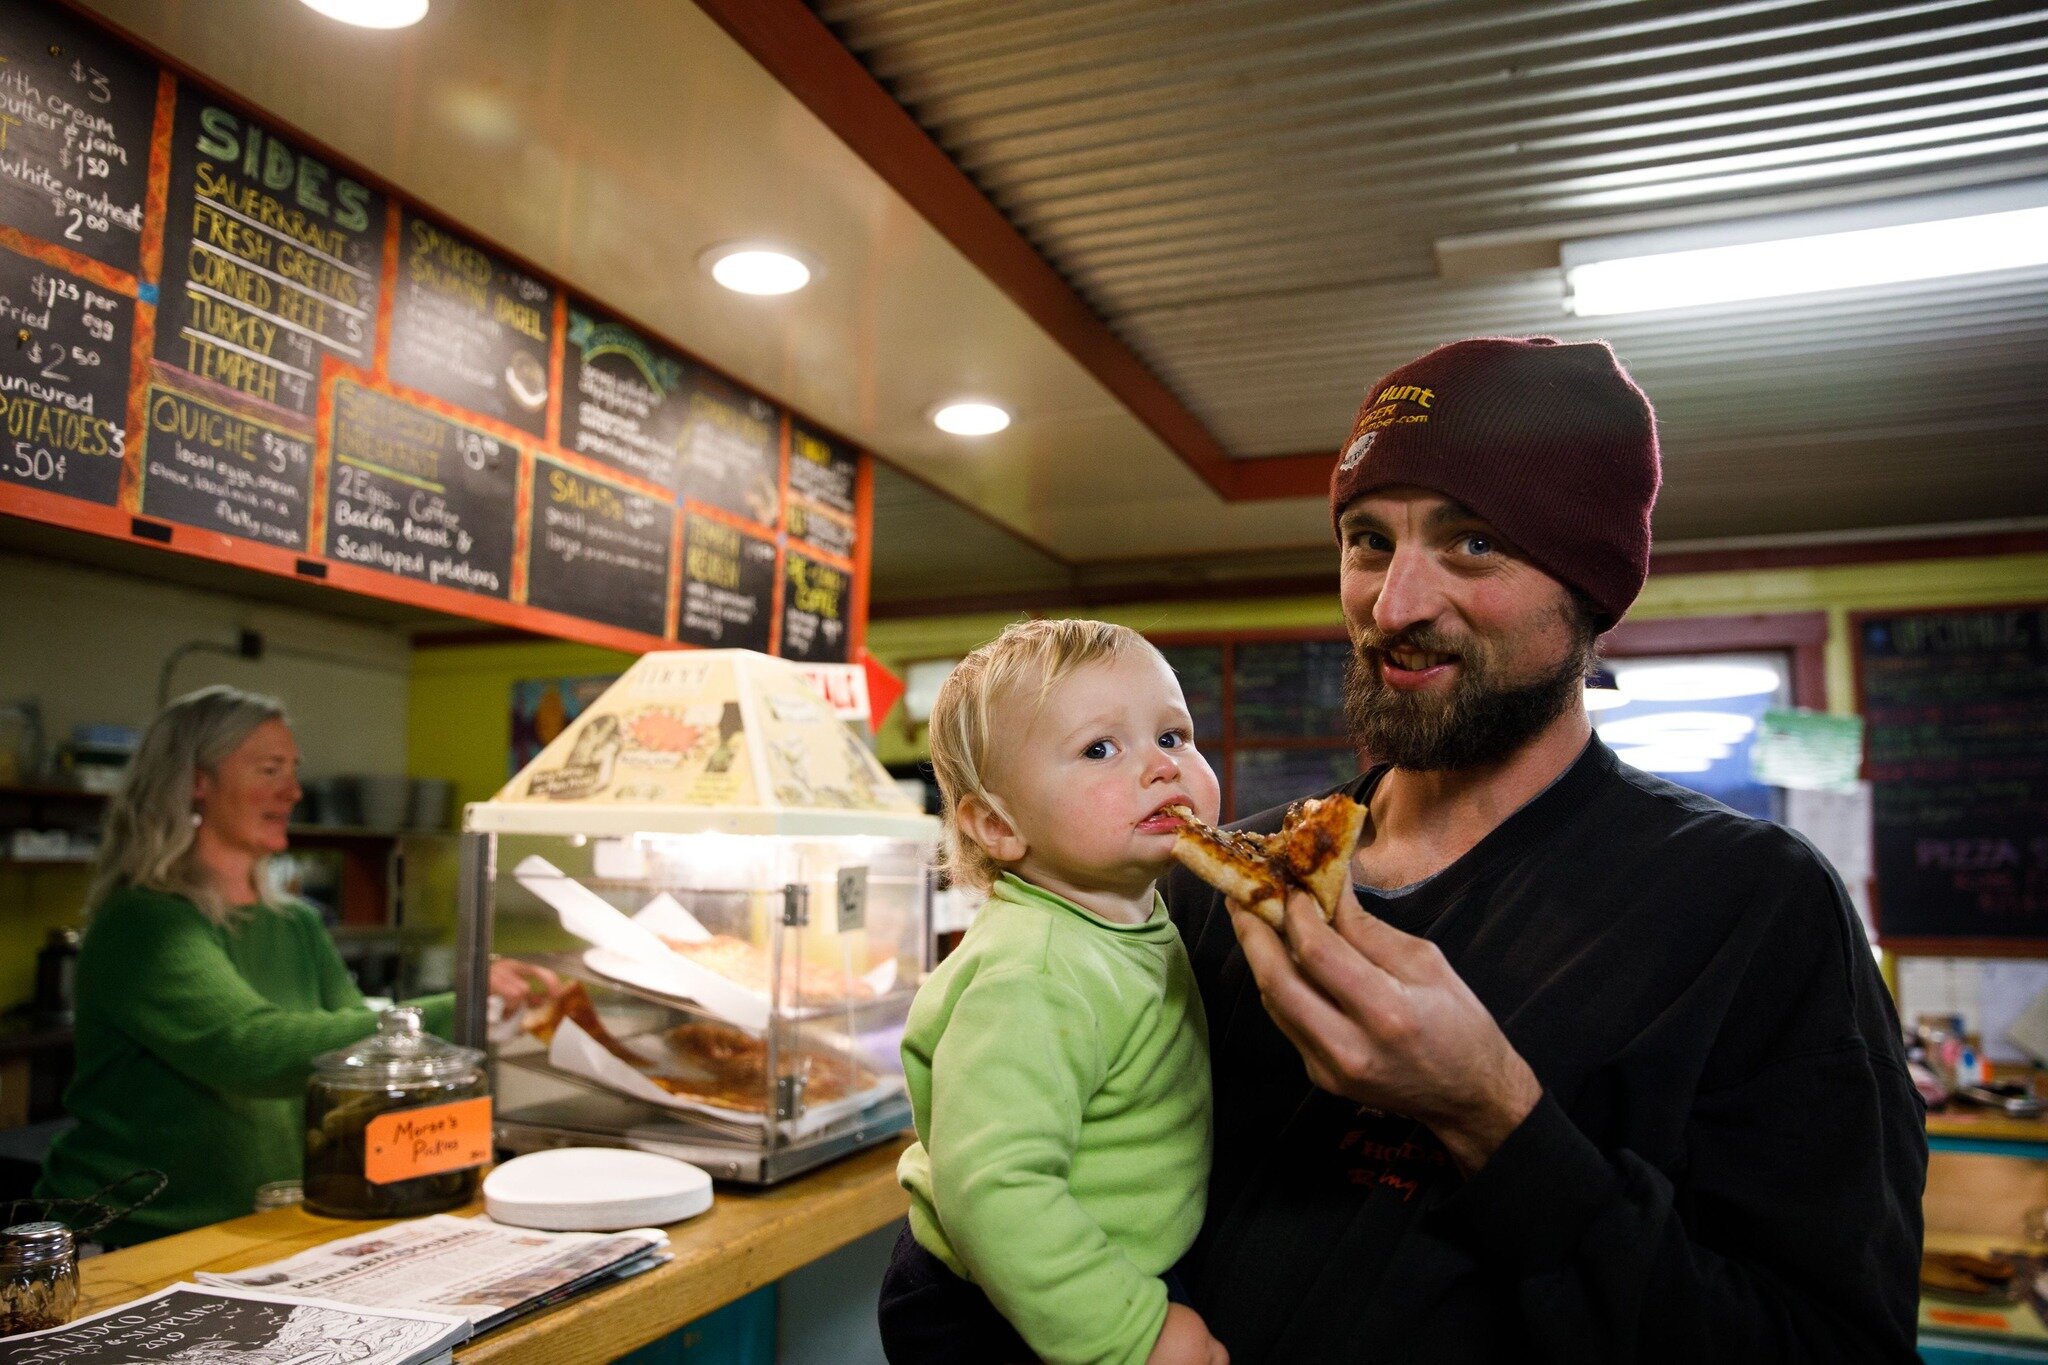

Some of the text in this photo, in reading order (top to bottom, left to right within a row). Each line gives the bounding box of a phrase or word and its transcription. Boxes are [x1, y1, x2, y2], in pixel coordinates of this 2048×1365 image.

[47, 94, 116, 140] cream
[79, 131, 128, 166] jam
[195, 106, 371, 233] SIDES
[0, 157, 63, 196] white
[85, 191, 145, 233] wheat
[193, 161, 348, 260] SAUERKRAUT
[192, 202, 273, 267] FRESH
[276, 244, 359, 308] GREENS
[84, 289, 118, 312] per
[187, 247, 272, 312] CORNED
[278, 284, 328, 335] BEEF
[186, 290, 277, 357] TURKEY
[179, 330, 277, 404] TEMPEH
[0, 374, 93, 415] uncured
[1374, 384, 1435, 408] Hunt
[152, 395, 258, 462] QUICHE
[175, 440, 215, 471] local
[335, 534, 425, 574] Scalloped
[49, 1315, 147, 1344] FEDCO
[121, 1303, 225, 1341] SUPPLIES
[136, 1331, 186, 1351] 2019
